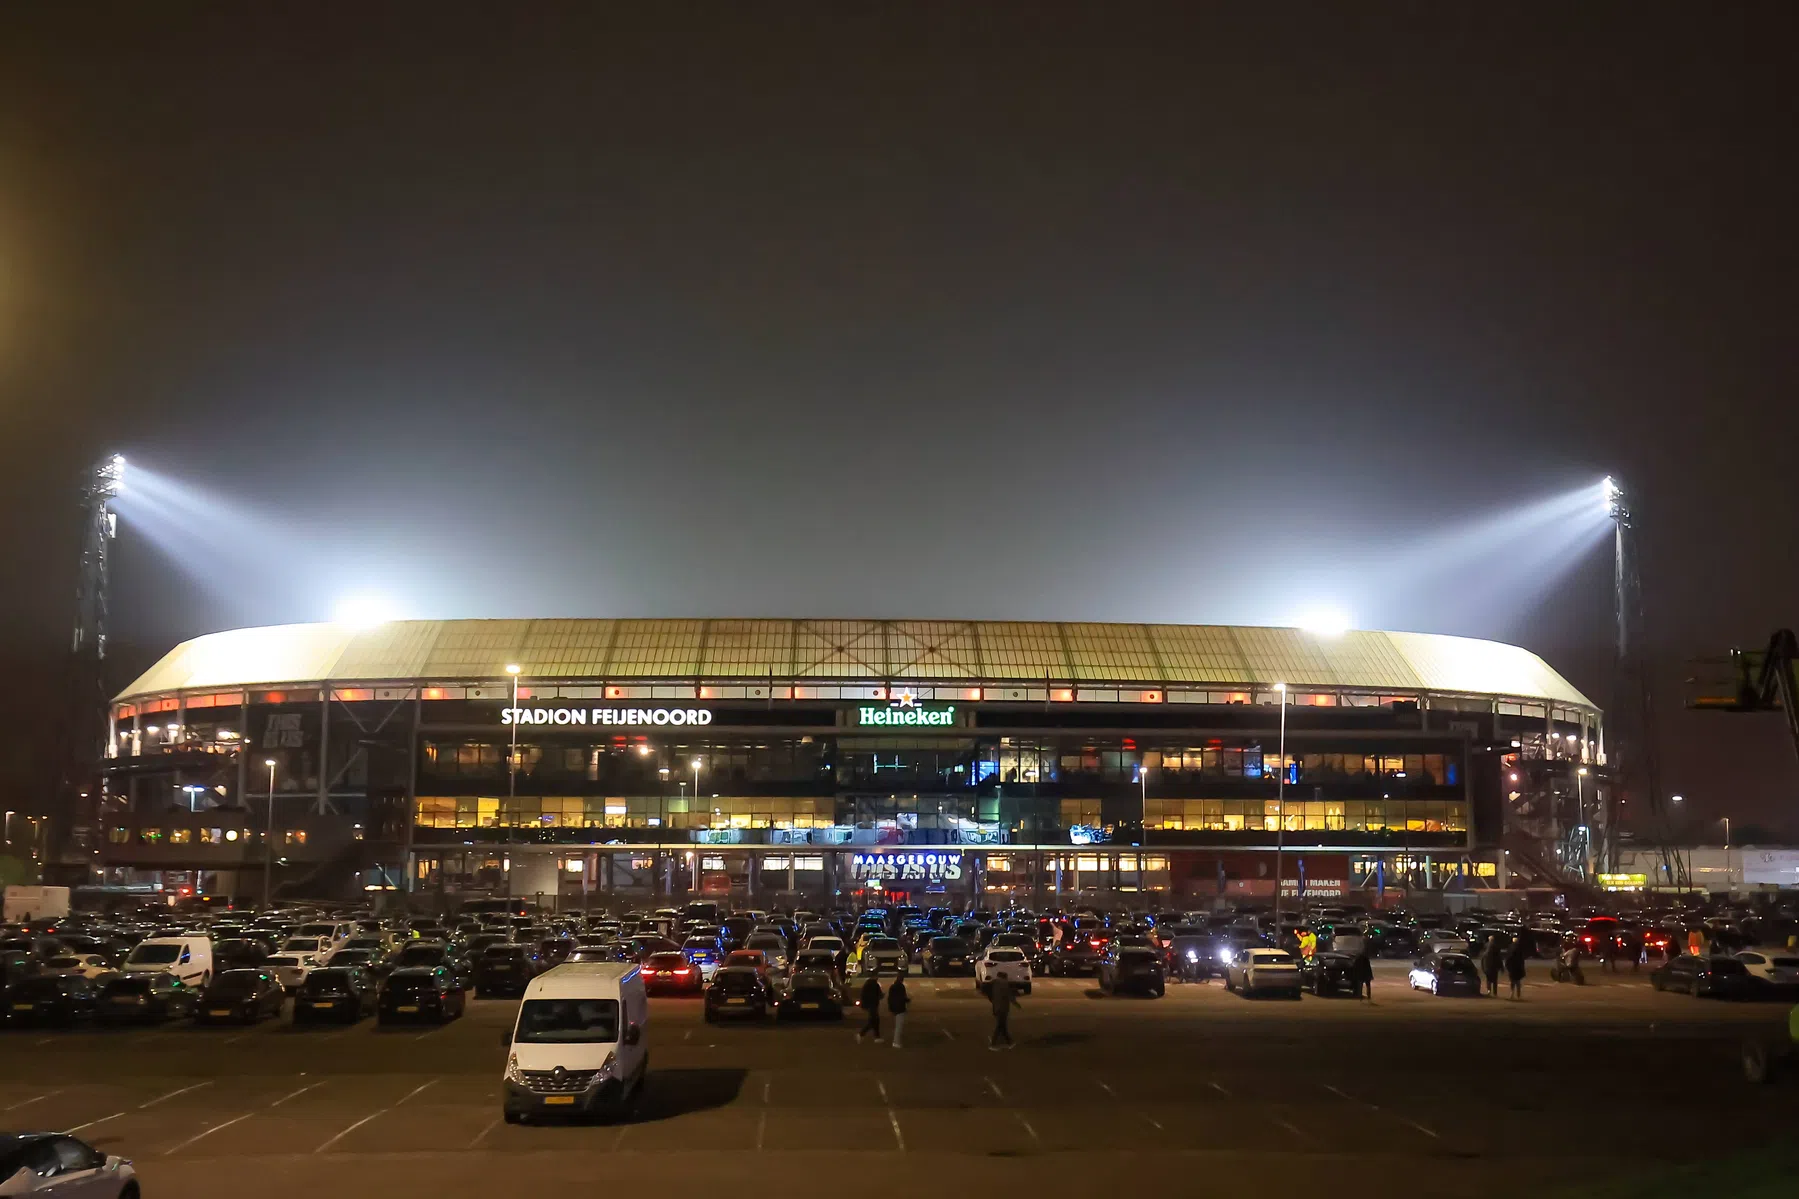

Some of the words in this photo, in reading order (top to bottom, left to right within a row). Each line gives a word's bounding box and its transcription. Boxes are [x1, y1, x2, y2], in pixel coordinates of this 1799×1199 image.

[501, 708, 587, 725] STADION
[592, 708, 712, 725] FEIJENOORD
[859, 707, 954, 725] Heineken
[853, 854, 961, 865] MAASGEBOUW
